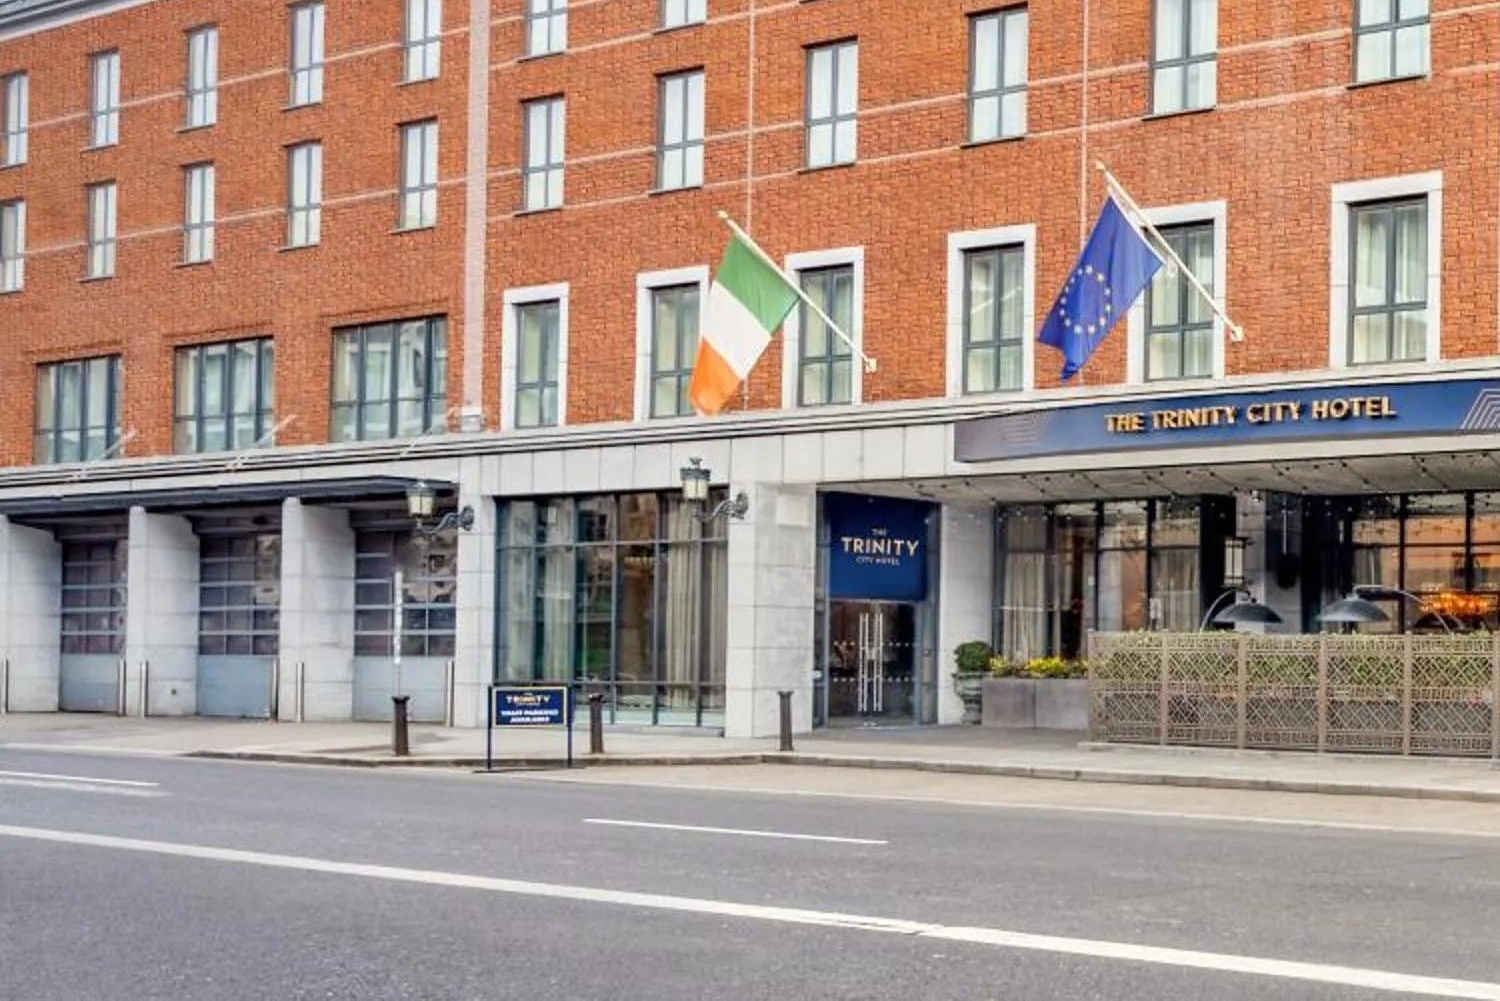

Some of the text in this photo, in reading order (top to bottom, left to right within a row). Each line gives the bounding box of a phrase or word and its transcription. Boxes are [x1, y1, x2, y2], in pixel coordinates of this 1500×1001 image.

[1104, 396, 1397, 432] THE TRINITY CITY HOTEL
[841, 536, 919, 558] TRINITY
